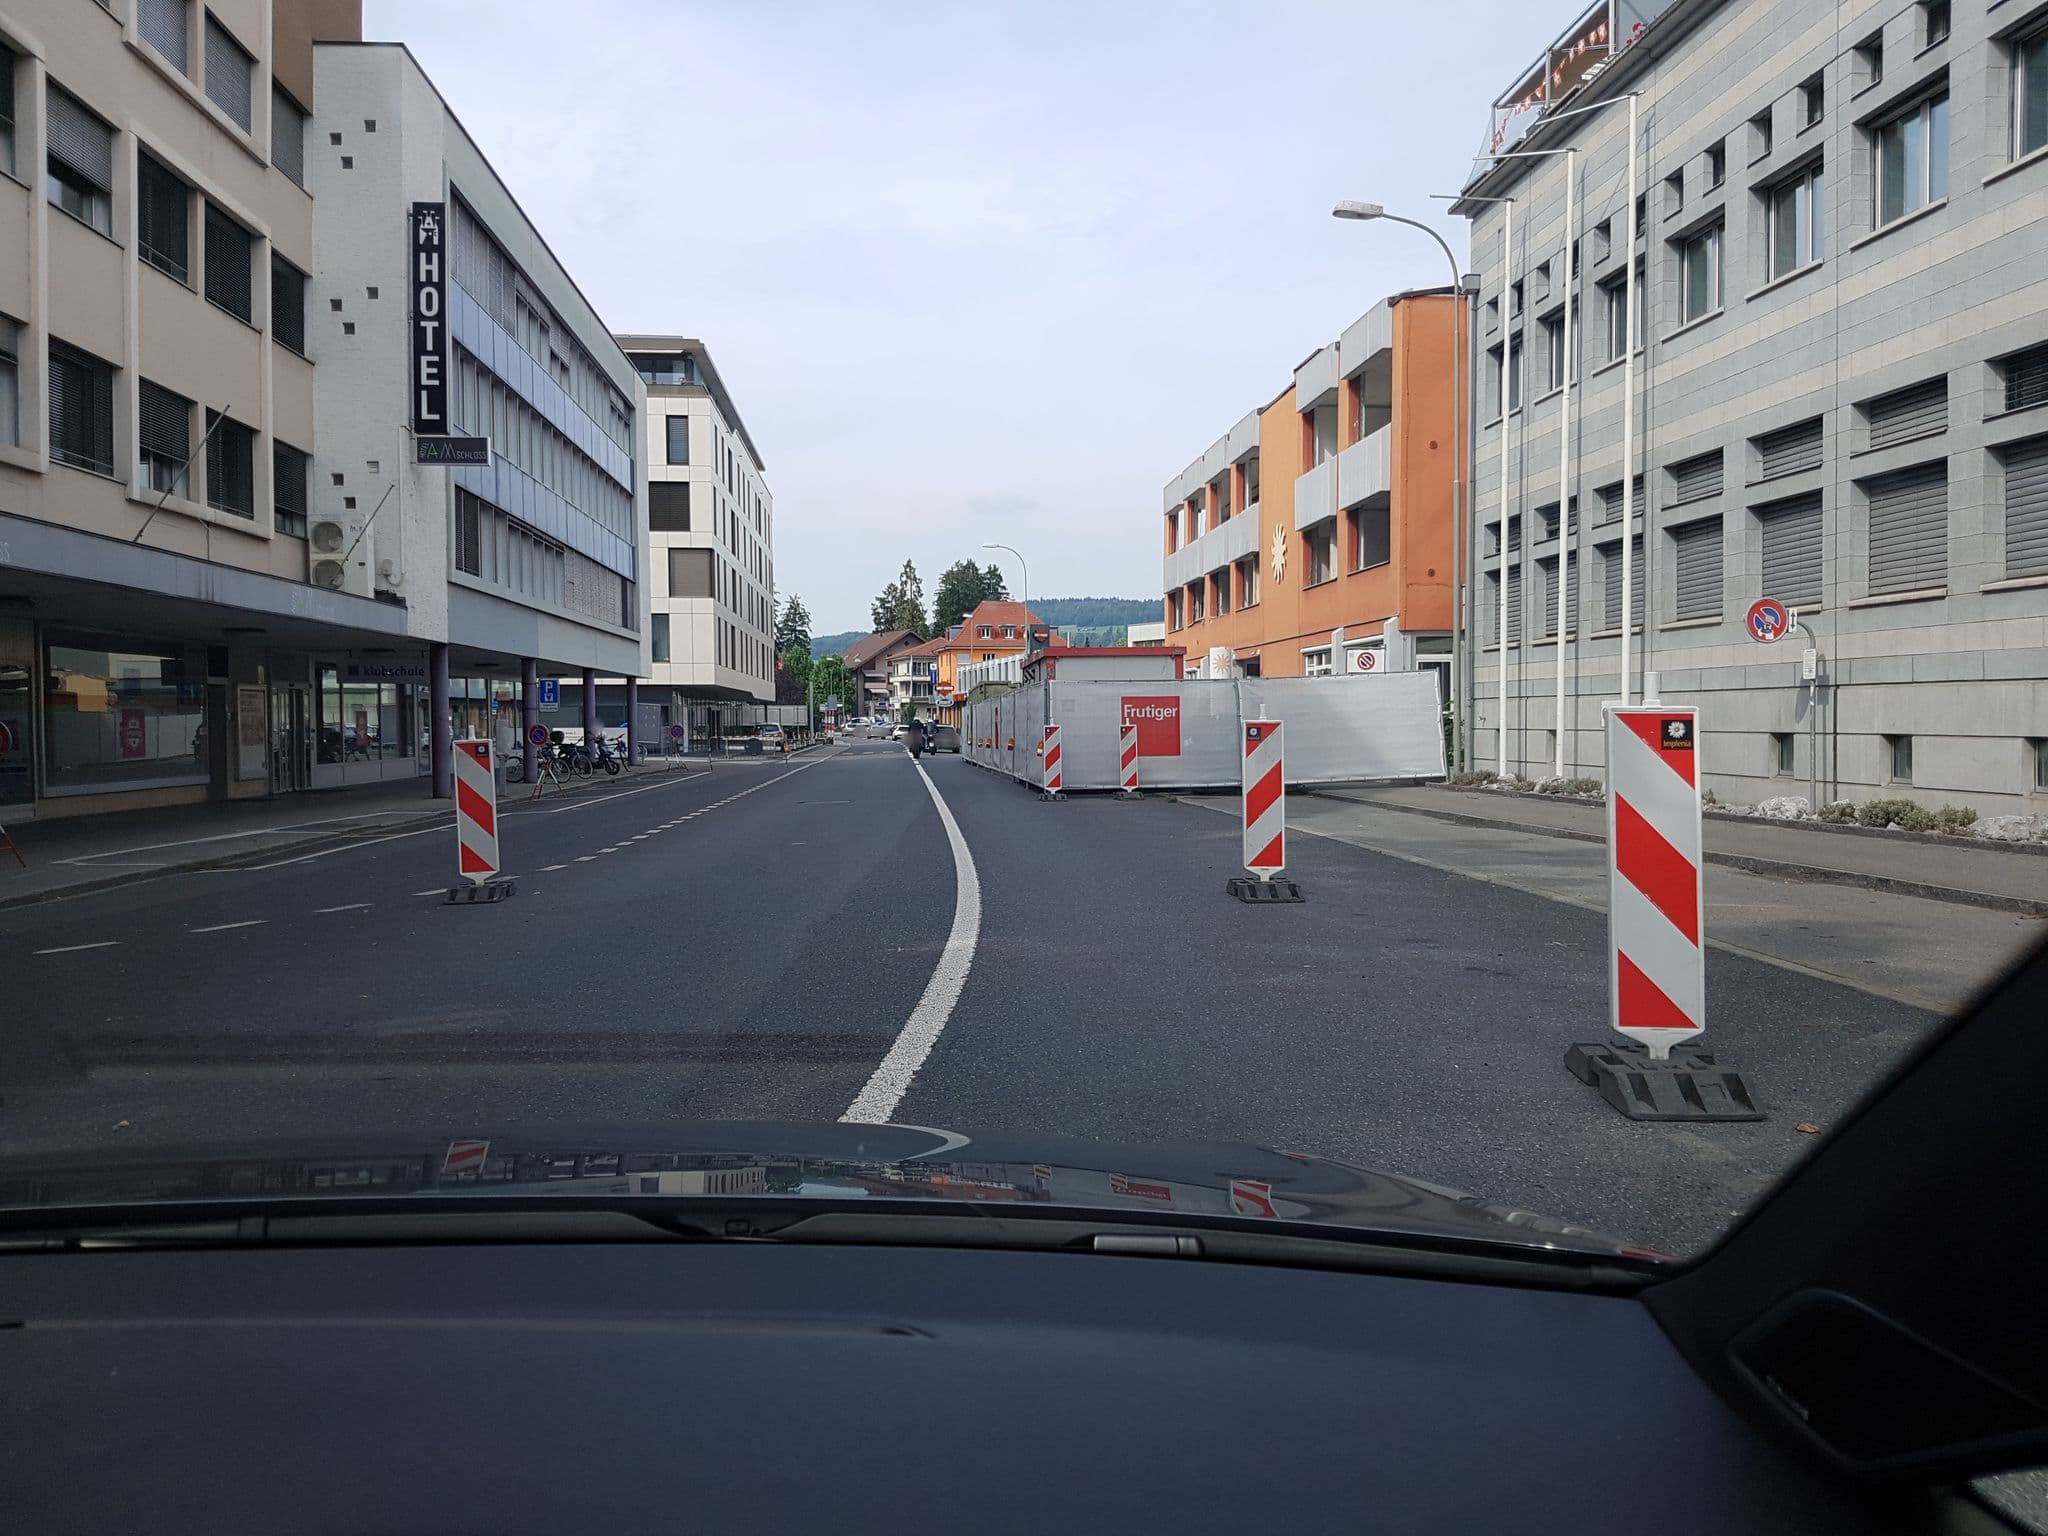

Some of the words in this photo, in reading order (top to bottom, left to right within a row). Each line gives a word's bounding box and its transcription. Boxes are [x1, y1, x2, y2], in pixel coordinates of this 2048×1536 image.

[419, 252, 440, 420] HOTEL
[456, 450, 487, 460] SCHLOSS
[363, 665, 425, 677] klubschule
[545, 681, 553, 692] P
[1123, 704, 1178, 721] Frutiger
